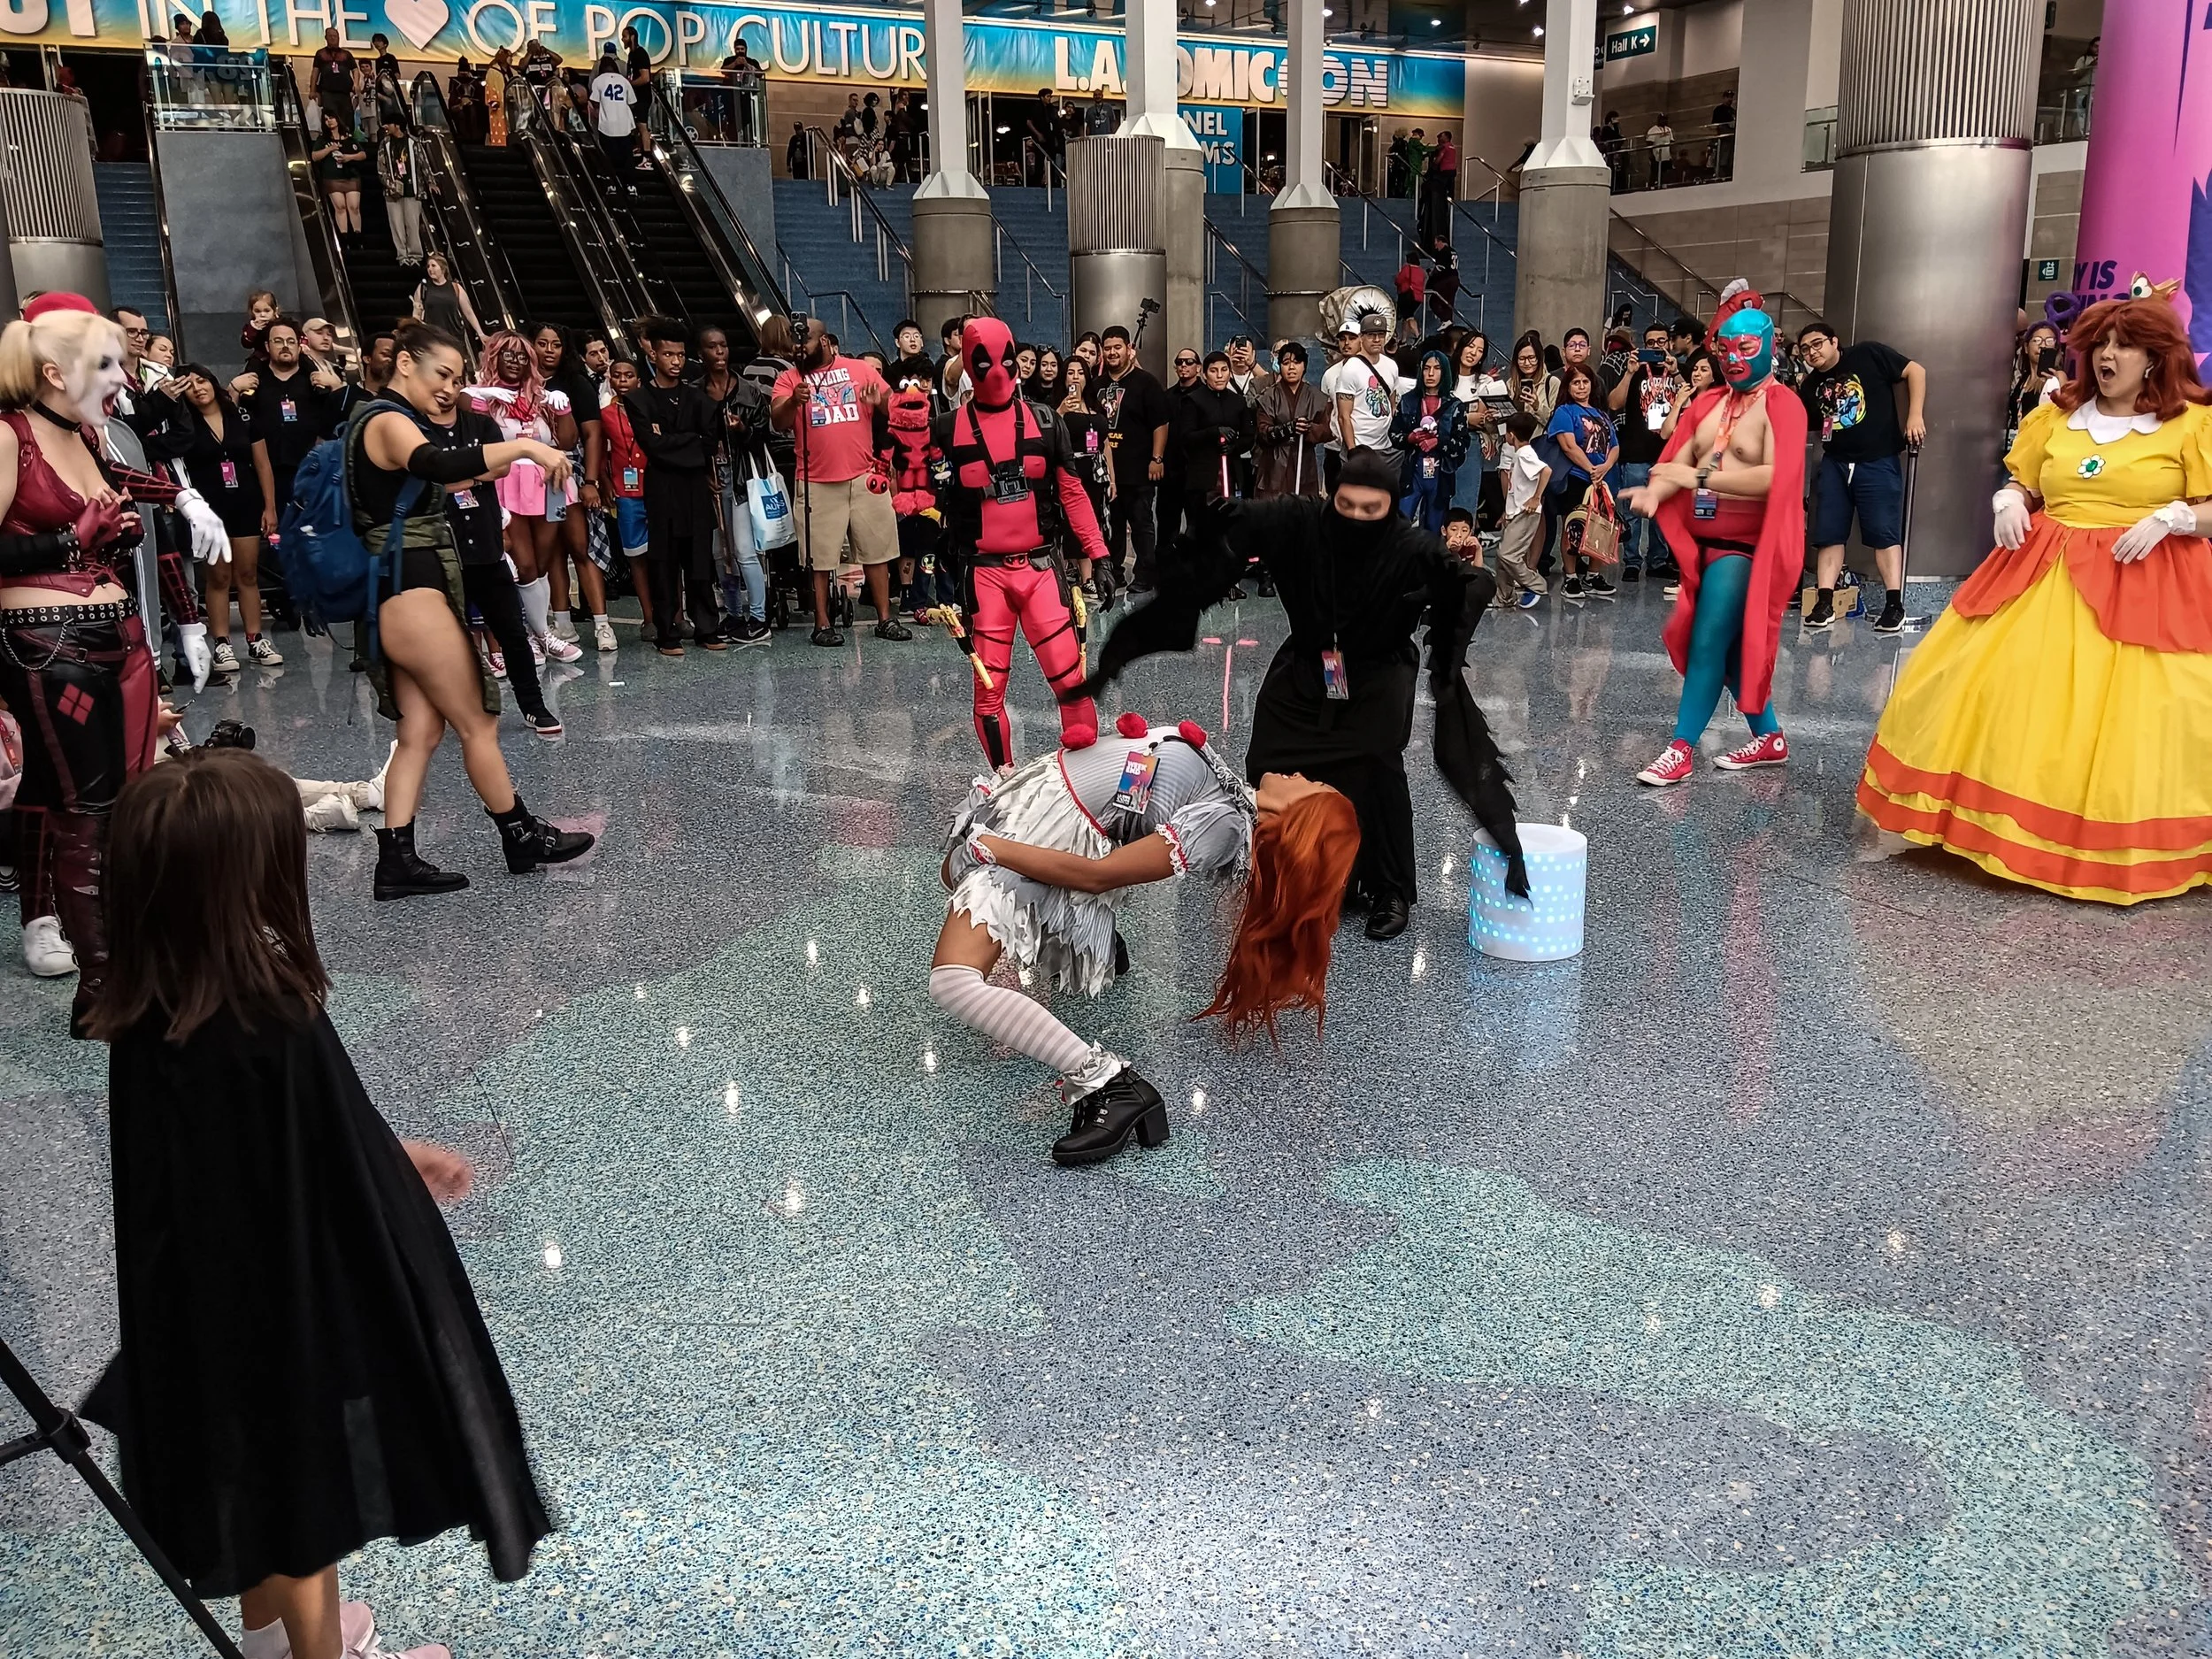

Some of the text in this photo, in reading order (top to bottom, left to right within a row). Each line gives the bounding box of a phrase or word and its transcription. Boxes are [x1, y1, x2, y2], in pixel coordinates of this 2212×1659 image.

[467, 0, 557, 56] OF
[585, 4, 705, 65] POP
[729, 14, 927, 81] CULTUR
[1611, 35, 1639, 54] Hall K
[1177, 44, 1275, 103] OMIC
[603, 83, 625, 101] 42
[1183, 110, 1227, 135] NEL
[2088, 260, 2118, 290] IS
